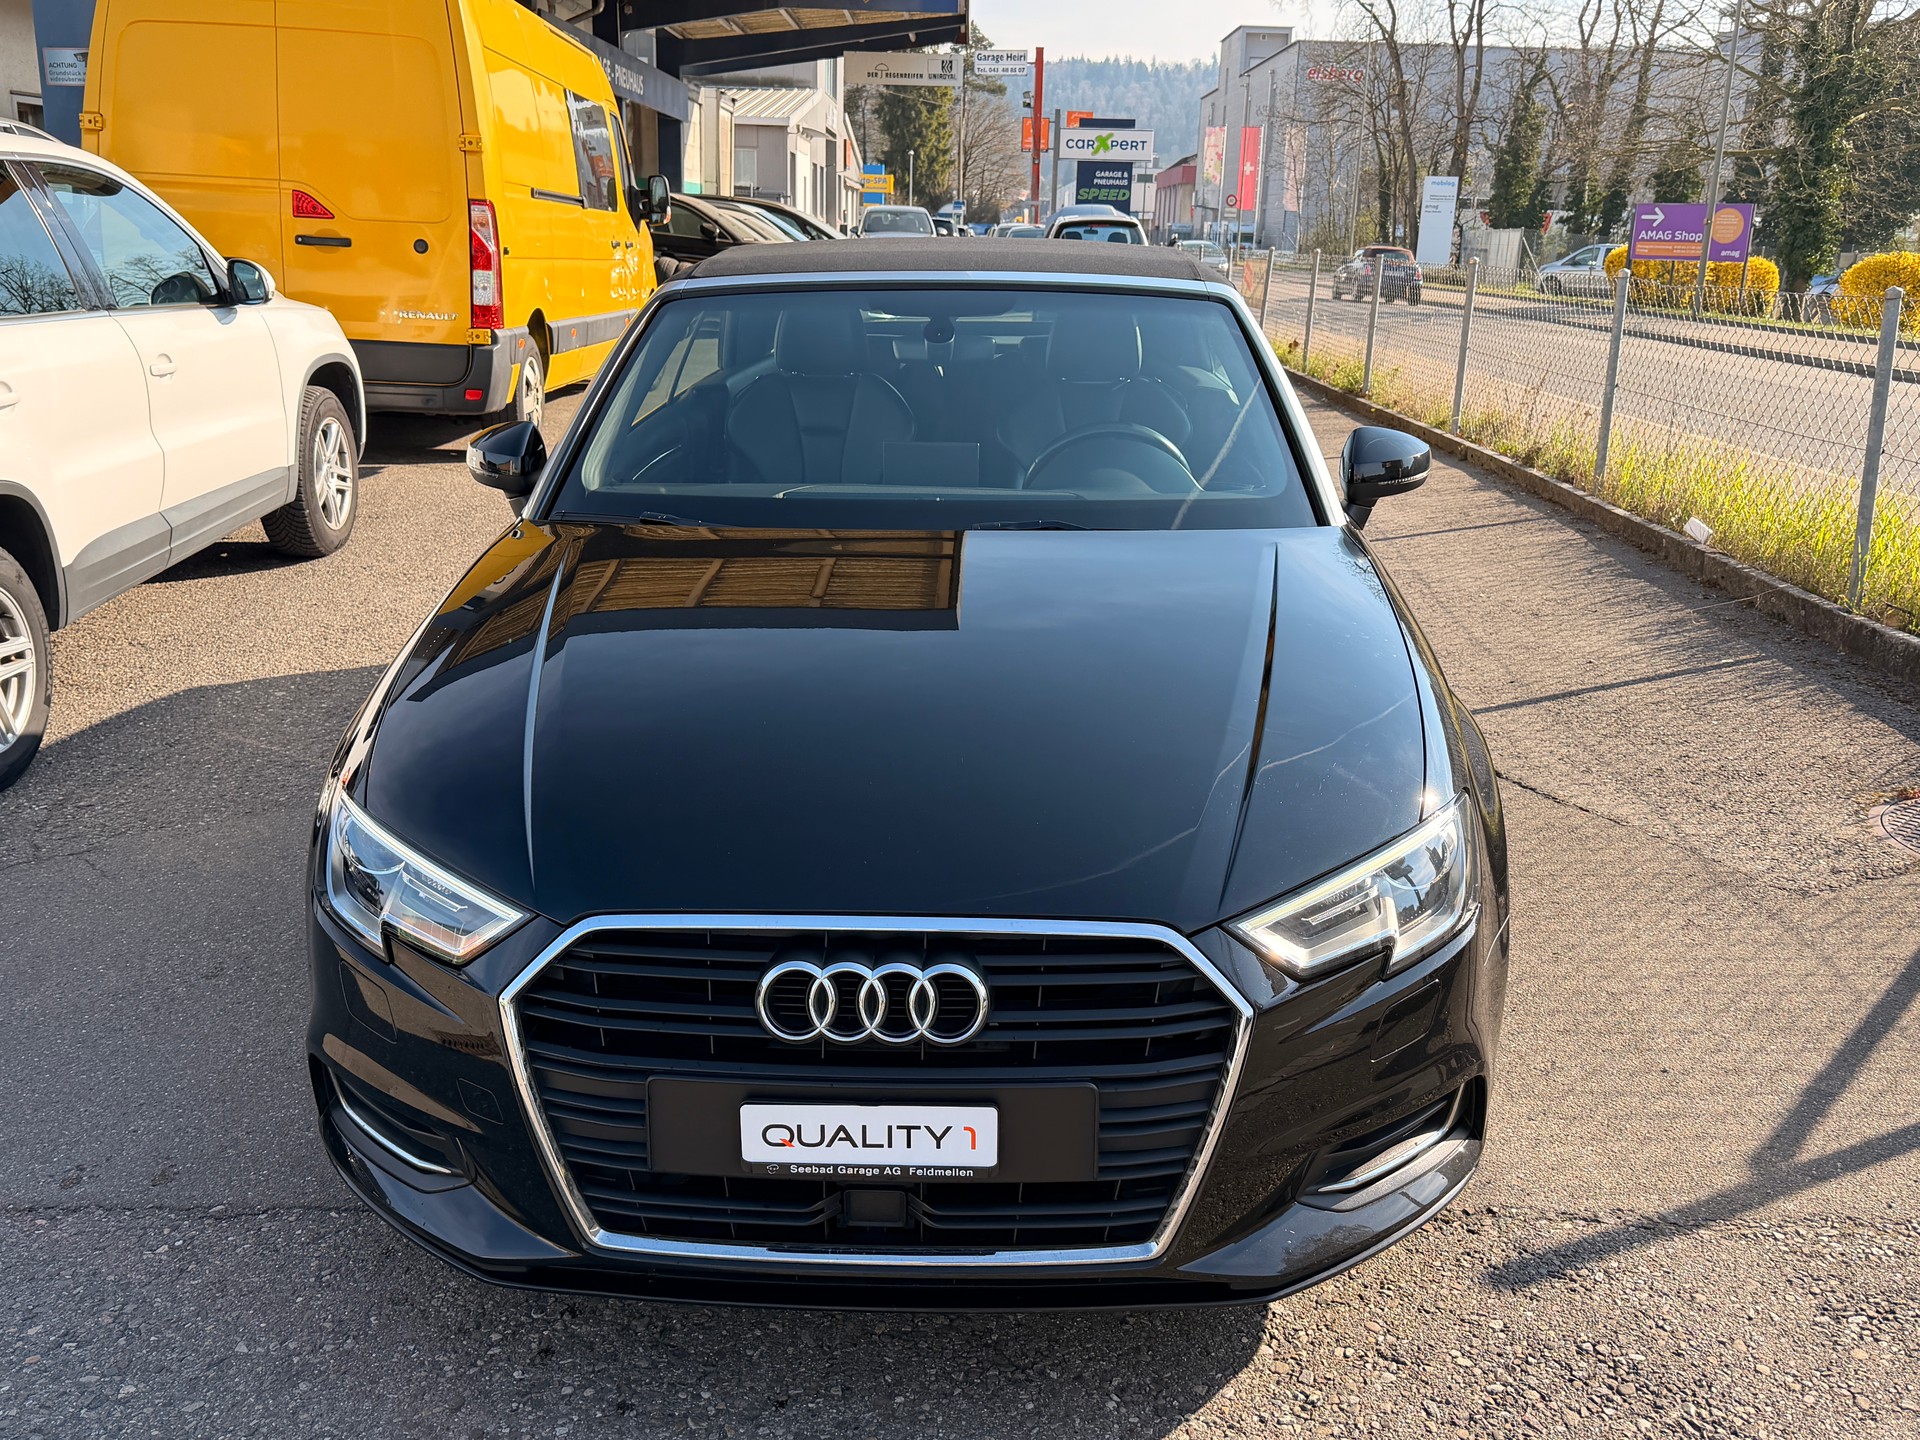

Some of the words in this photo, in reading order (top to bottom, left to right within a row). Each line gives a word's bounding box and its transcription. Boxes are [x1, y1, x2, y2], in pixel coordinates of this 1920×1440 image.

[976, 52, 1004, 64] Garage
[1006, 52, 1026, 62] Heiri
[614, 64, 644, 96] PNEUHAUS
[1095, 170, 1122, 178] GARAGE
[1123, 170, 1129, 178] &
[1077, 188, 1131, 201] SPEED
[1638, 230, 1672, 241] AMAG
[1674, 230, 1703, 243] Shop
[1720, 249, 1741, 258] amag
[399, 310, 458, 321] RENAULT
[761, 1123, 953, 1150] QUALITY
[963, 1125, 977, 1150] 1
[790, 1164, 834, 1175] Seebad
[837, 1165, 880, 1176] Garage
[883, 1166, 901, 1176] AG
